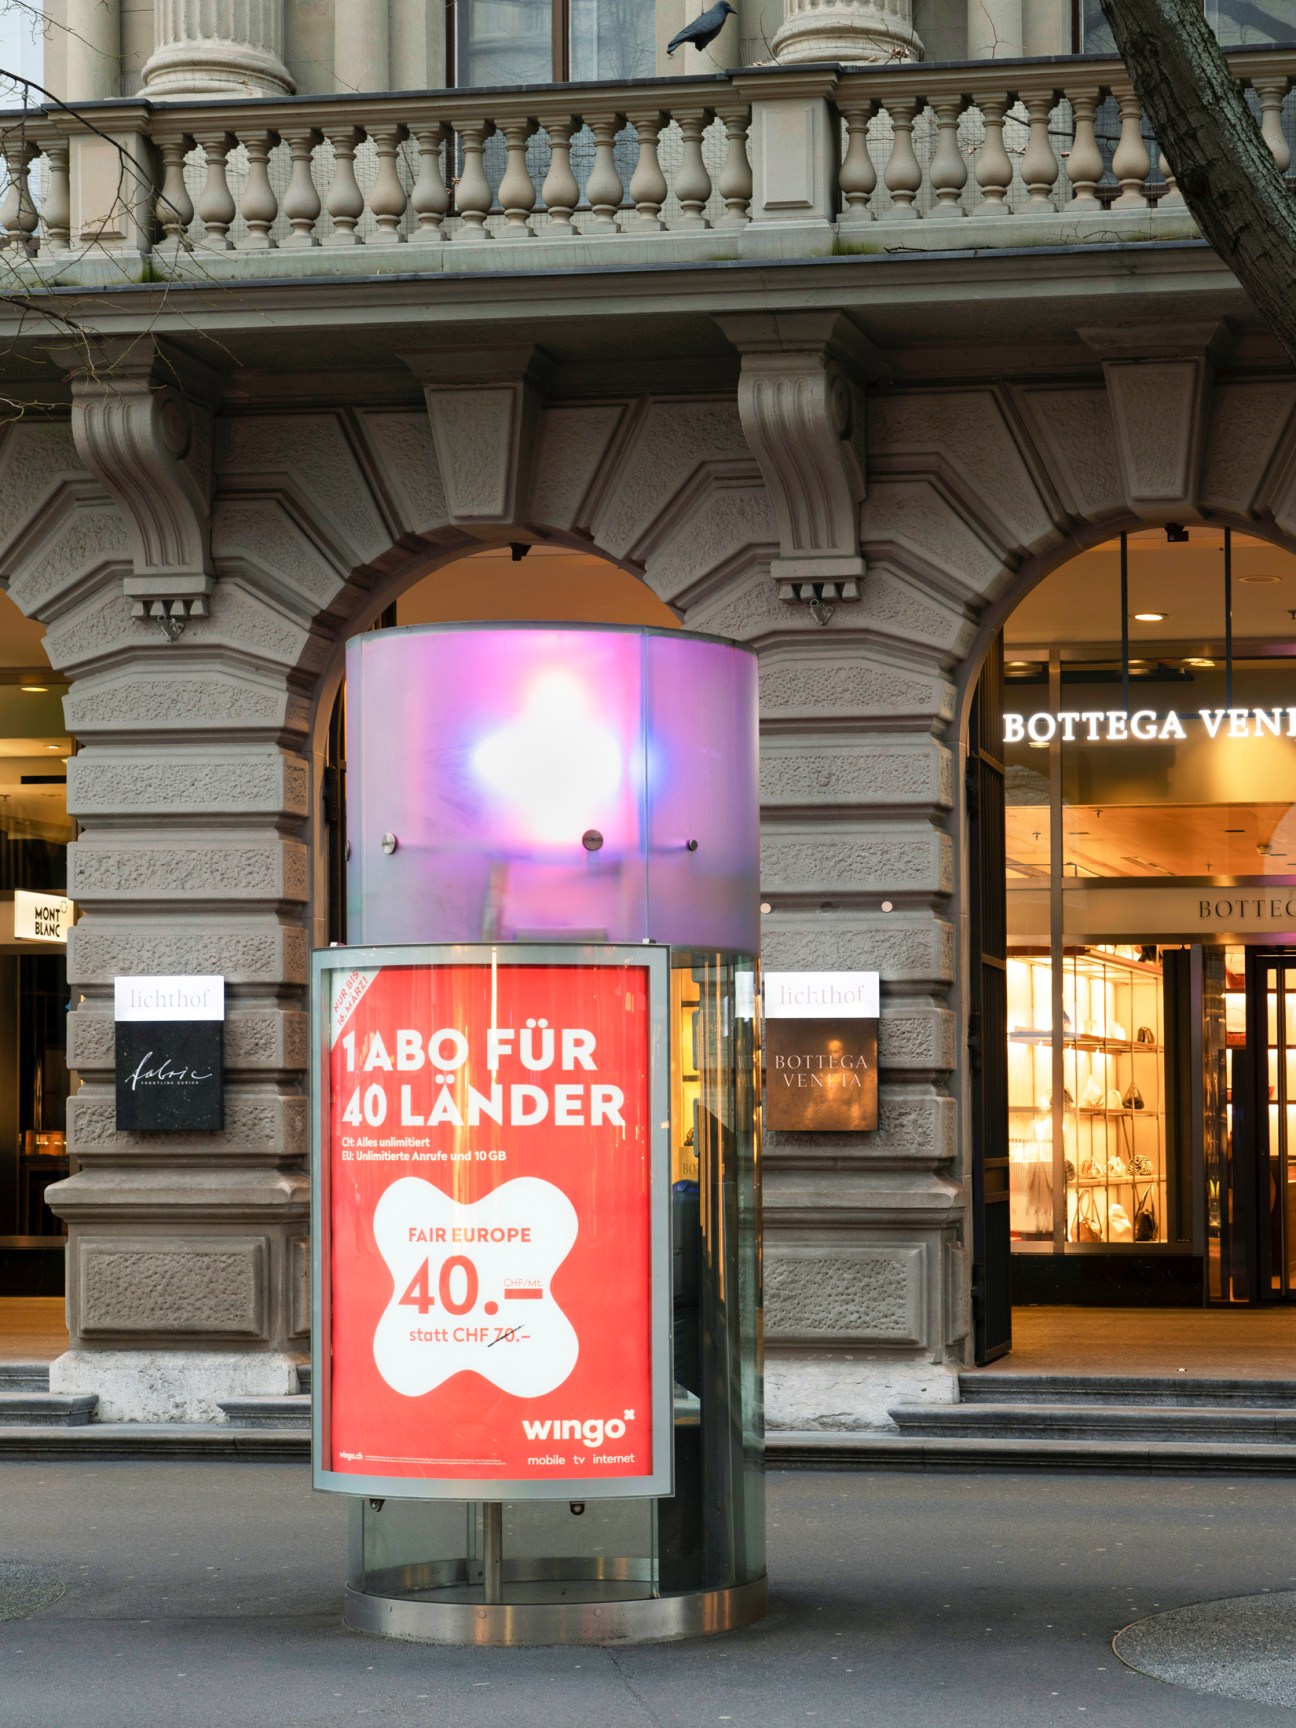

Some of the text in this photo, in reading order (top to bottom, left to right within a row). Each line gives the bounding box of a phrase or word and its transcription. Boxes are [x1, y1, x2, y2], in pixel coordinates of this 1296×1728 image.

[1003, 710, 1187, 743] BOTTEGA
[35, 906, 61, 922] MONT
[35, 921, 60, 938] BLANC
[130, 989, 211, 1008] lichthof
[334, 969, 360, 1013] NUR BIS
[780, 985, 865, 1005] lichthof
[487, 1018, 598, 1071] FÜR
[124, 1051, 213, 1091] fabric
[775, 1055, 868, 1069] BOTTEGA
[342, 1074, 626, 1127] 40 LÄNDER
[342, 1137, 430, 1147] CH: Alles unlimitiert
[342, 1151, 507, 1161] EU: Unlimitierte Anrufe und 10 GB
[408, 1227, 532, 1243] FAIR EUROPE
[409, 1327, 449, 1342] statt
[453, 1327, 489, 1342] CHF
[521, 1418, 626, 1448] wingo
[527, 1453, 635, 1465] mobile tv internet
